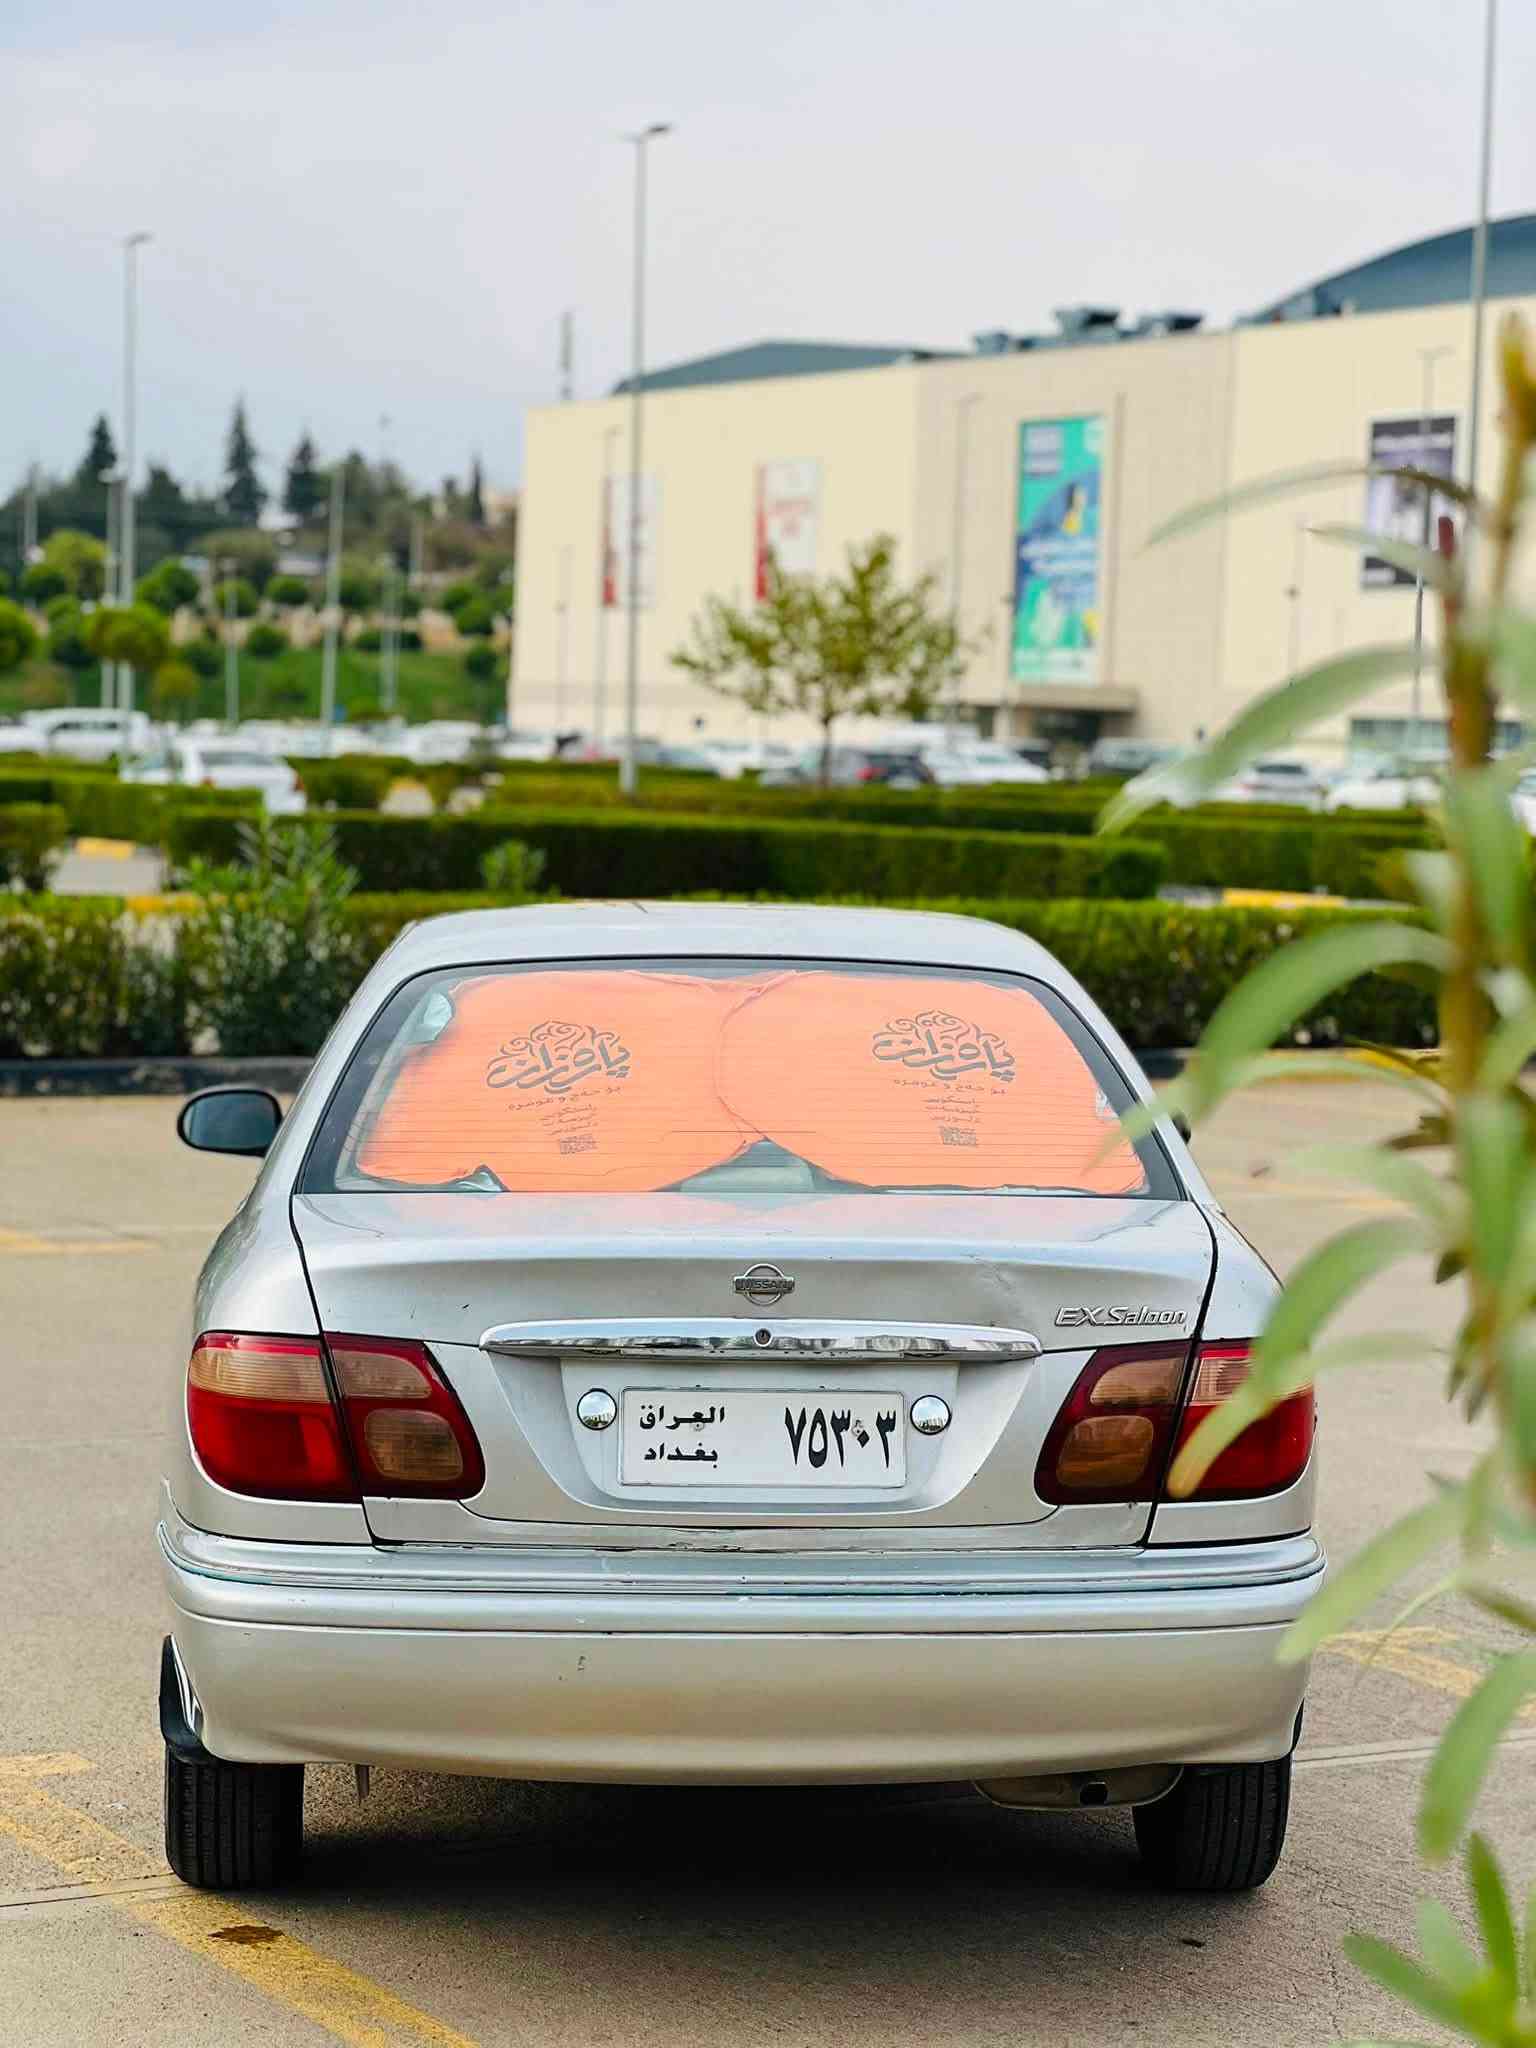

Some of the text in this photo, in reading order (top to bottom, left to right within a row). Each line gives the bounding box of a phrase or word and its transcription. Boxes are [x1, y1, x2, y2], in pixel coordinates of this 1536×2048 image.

[1055, 1306, 1187, 1327] EX Saloon
[639, 1403, 726, 1431] العراق
[784, 1406, 897, 1469] ٧٥٣٠٣
[644, 1442, 719, 1469] بغداد
